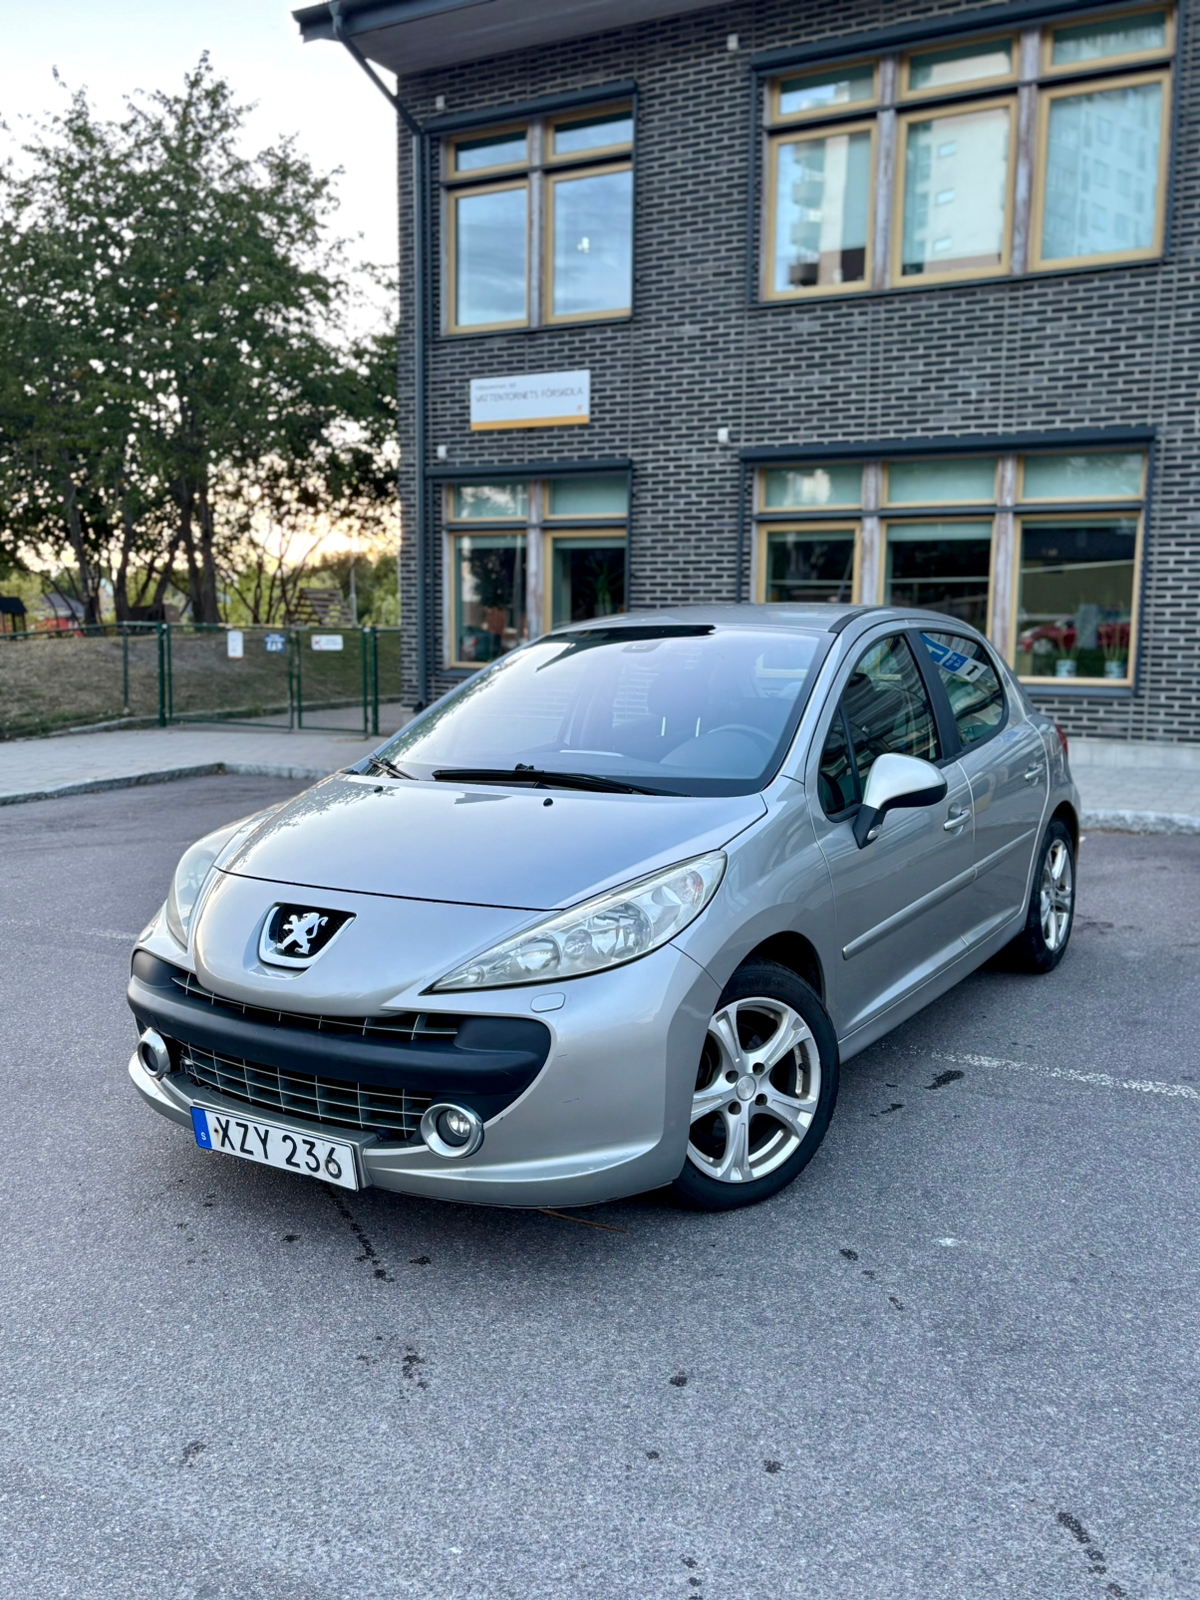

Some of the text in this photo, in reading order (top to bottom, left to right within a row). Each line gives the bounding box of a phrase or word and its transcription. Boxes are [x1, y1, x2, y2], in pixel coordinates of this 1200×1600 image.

[200, 1131, 207, 1141] S
[215, 1116, 342, 1180] XZY 236
